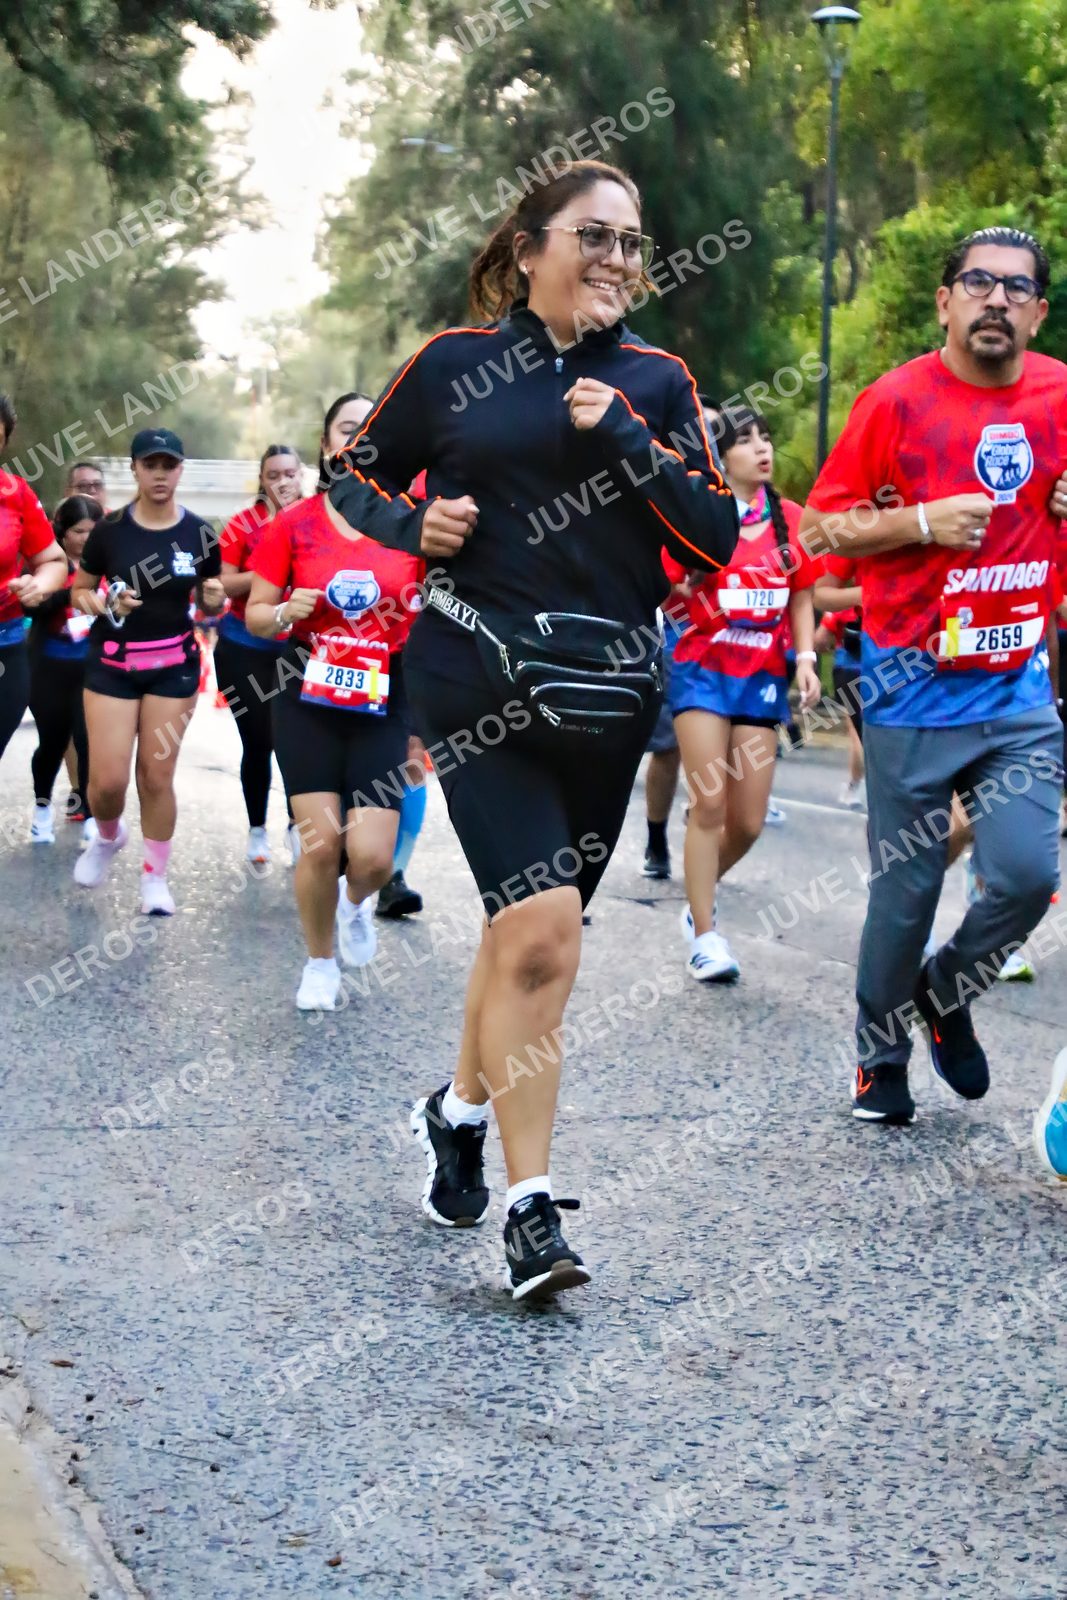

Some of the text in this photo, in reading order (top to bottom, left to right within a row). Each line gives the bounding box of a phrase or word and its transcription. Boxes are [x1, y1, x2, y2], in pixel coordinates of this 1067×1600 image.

[943, 559, 1049, 595] SANTIAGO
[746, 591, 774, 606] 1720
[975, 624, 1023, 652] 2659
[325, 666, 365, 689] 2833
